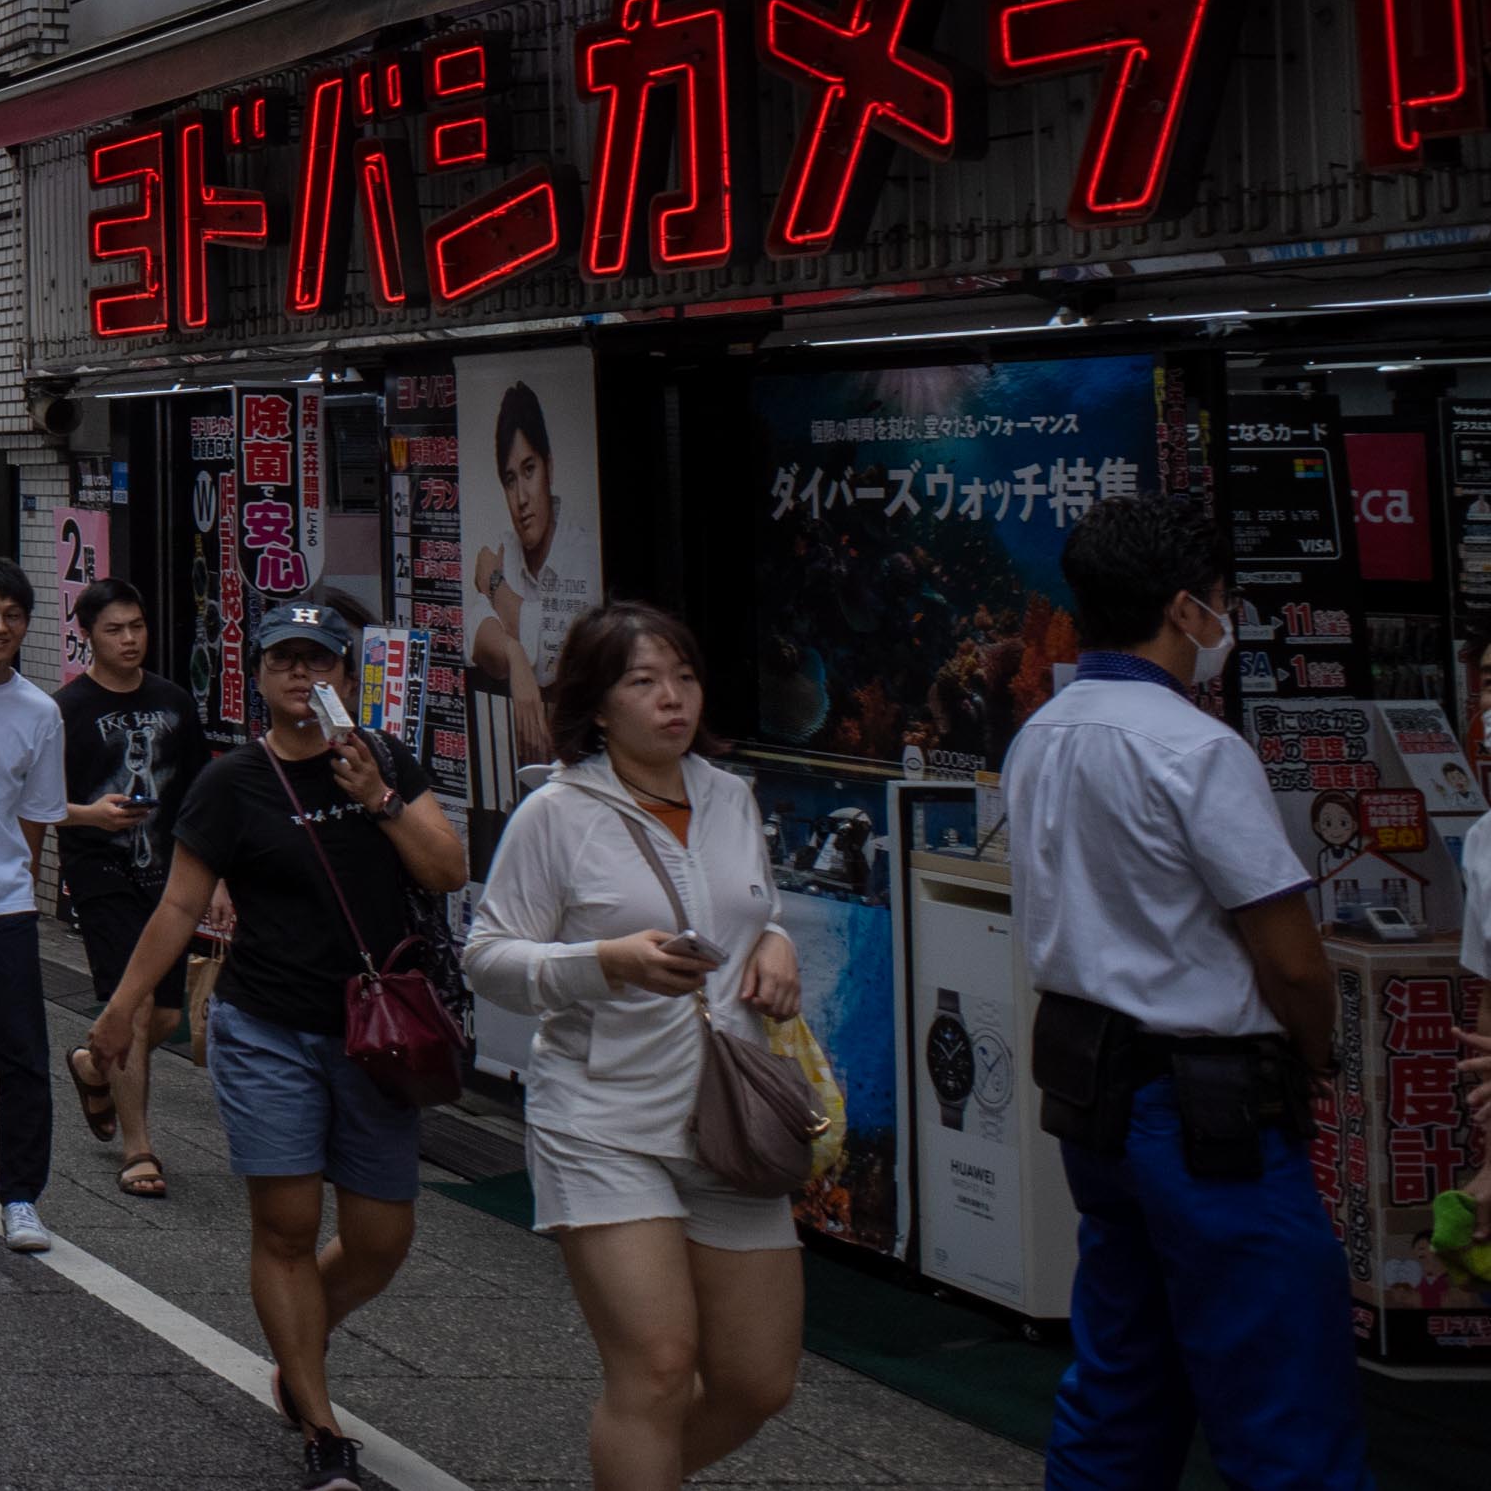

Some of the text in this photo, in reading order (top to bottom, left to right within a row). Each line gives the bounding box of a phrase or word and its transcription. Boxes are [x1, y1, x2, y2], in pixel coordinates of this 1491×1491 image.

[302, 394, 320, 548] 店内は天井照明による
[241, 392, 310, 593] 除菌で安心
[770, 456, 1142, 528] ダイバーズウォッチ特集
[1298, 537, 1336, 554] VISA
[291, 608, 320, 625] H
[1281, 601, 1316, 637] 11
[1257, 708, 1369, 735] 家にいながら
[1259, 735, 1368, 762] 外の温度が
[1382, 974, 1465, 1206] 温度計
[950, 1158, 996, 1186] HUAWEI
